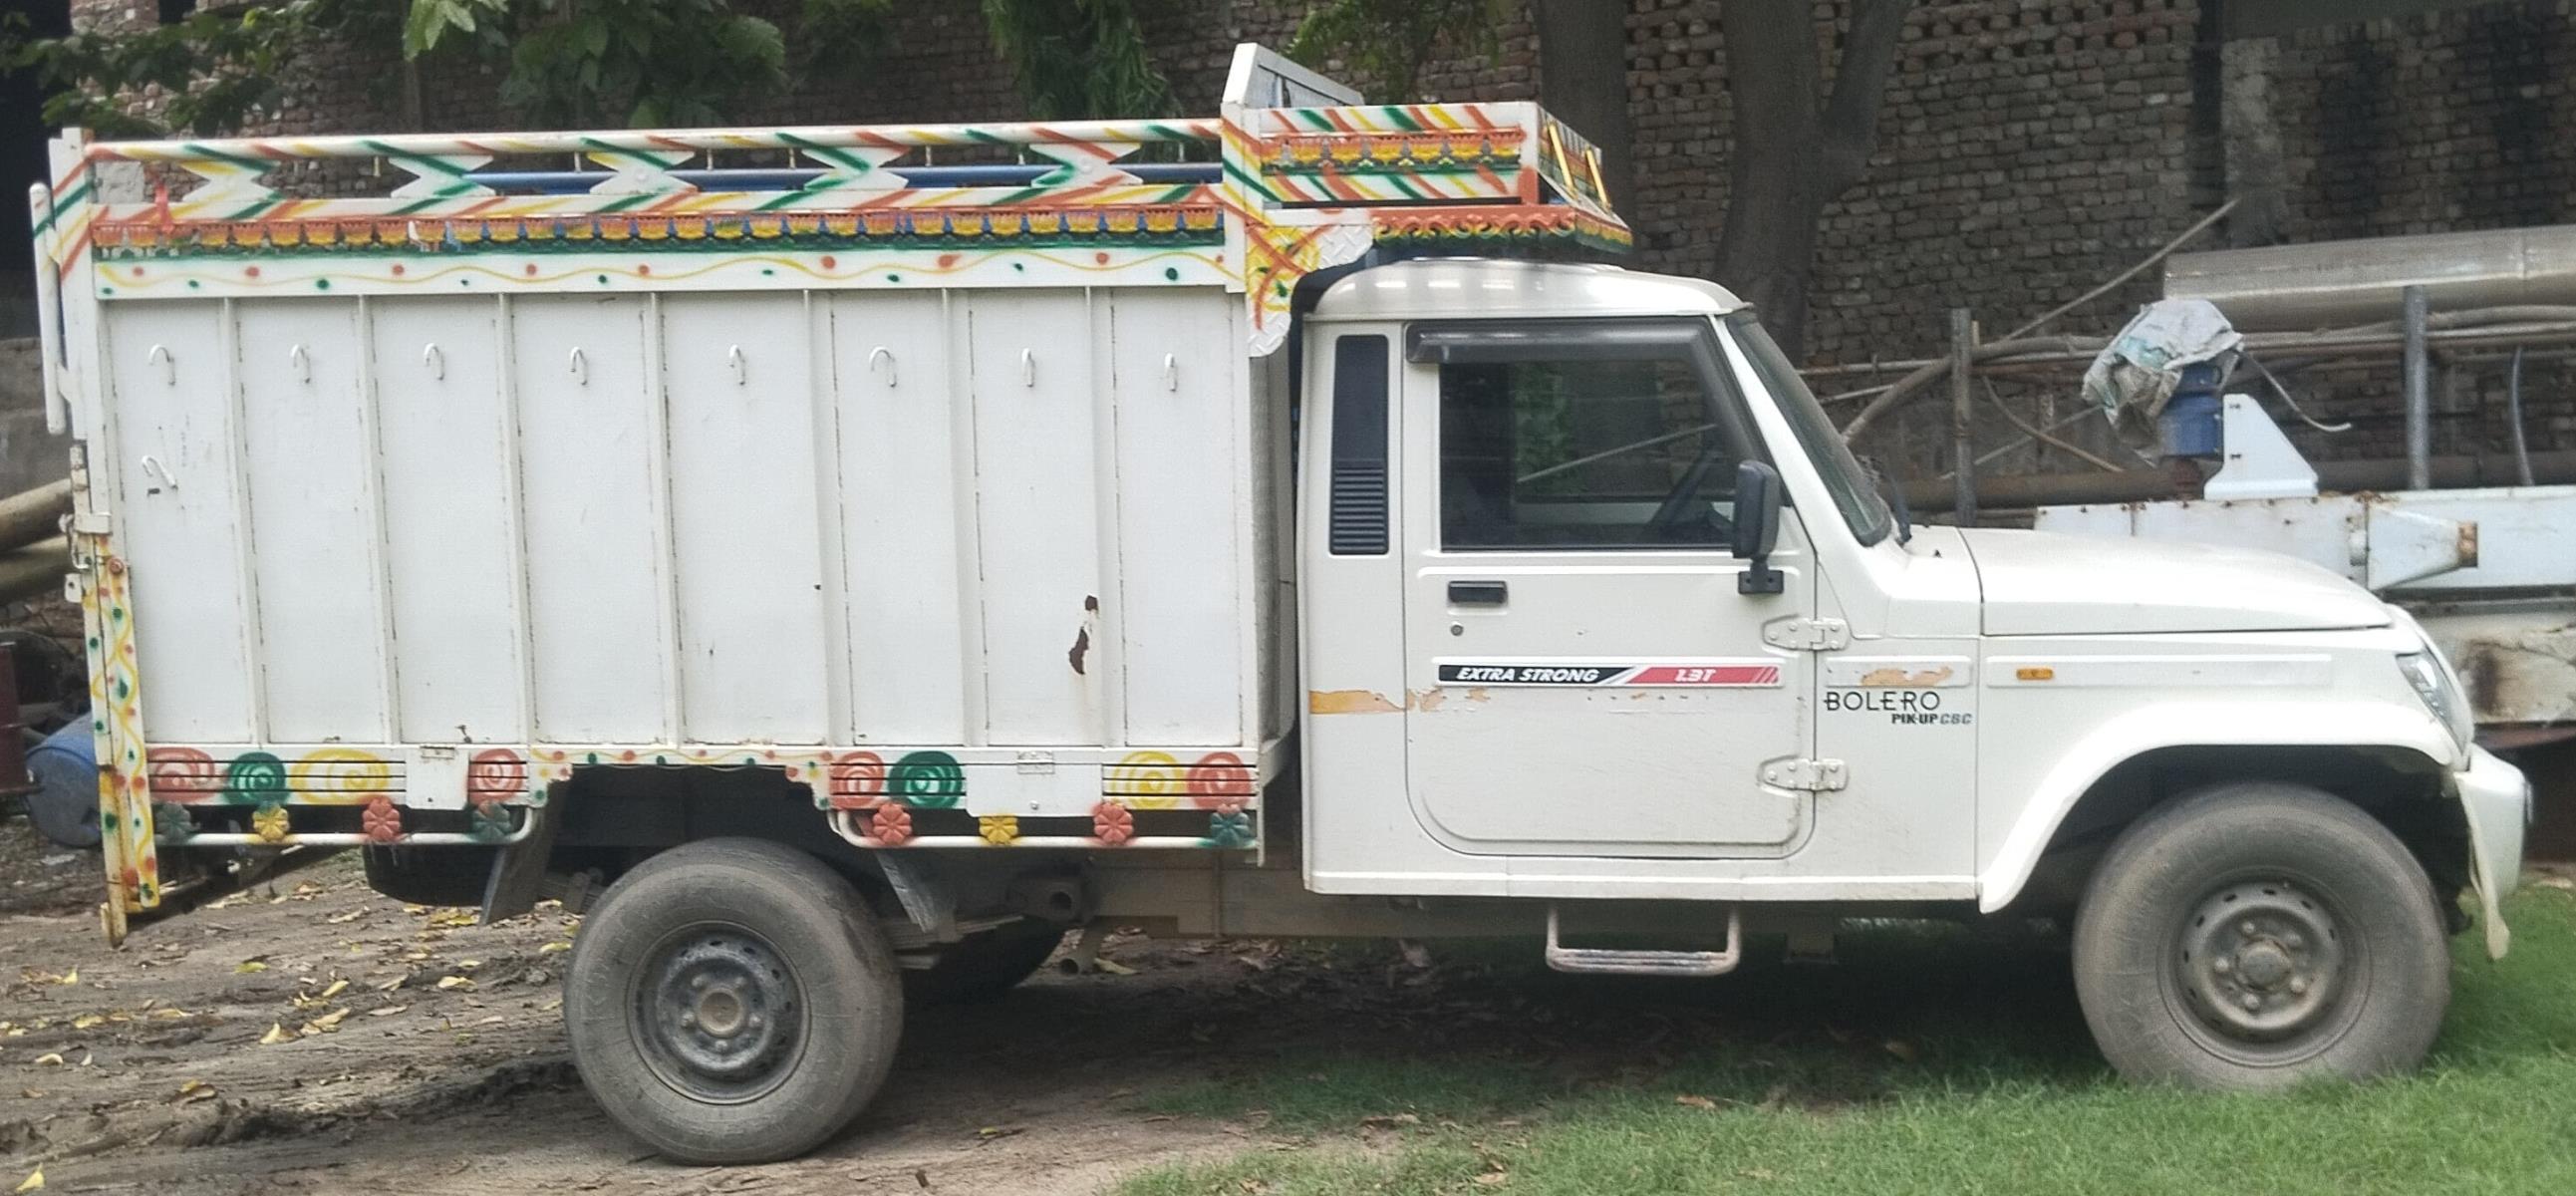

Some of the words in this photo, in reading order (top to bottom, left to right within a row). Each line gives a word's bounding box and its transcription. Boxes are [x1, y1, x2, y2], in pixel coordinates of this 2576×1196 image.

[1456, 667, 1516, 681] EXTRA
[1519, 668, 1600, 683] STRONG
[1823, 691, 1940, 712] BOLERO
[1891, 713, 1938, 725] PIK-UP
